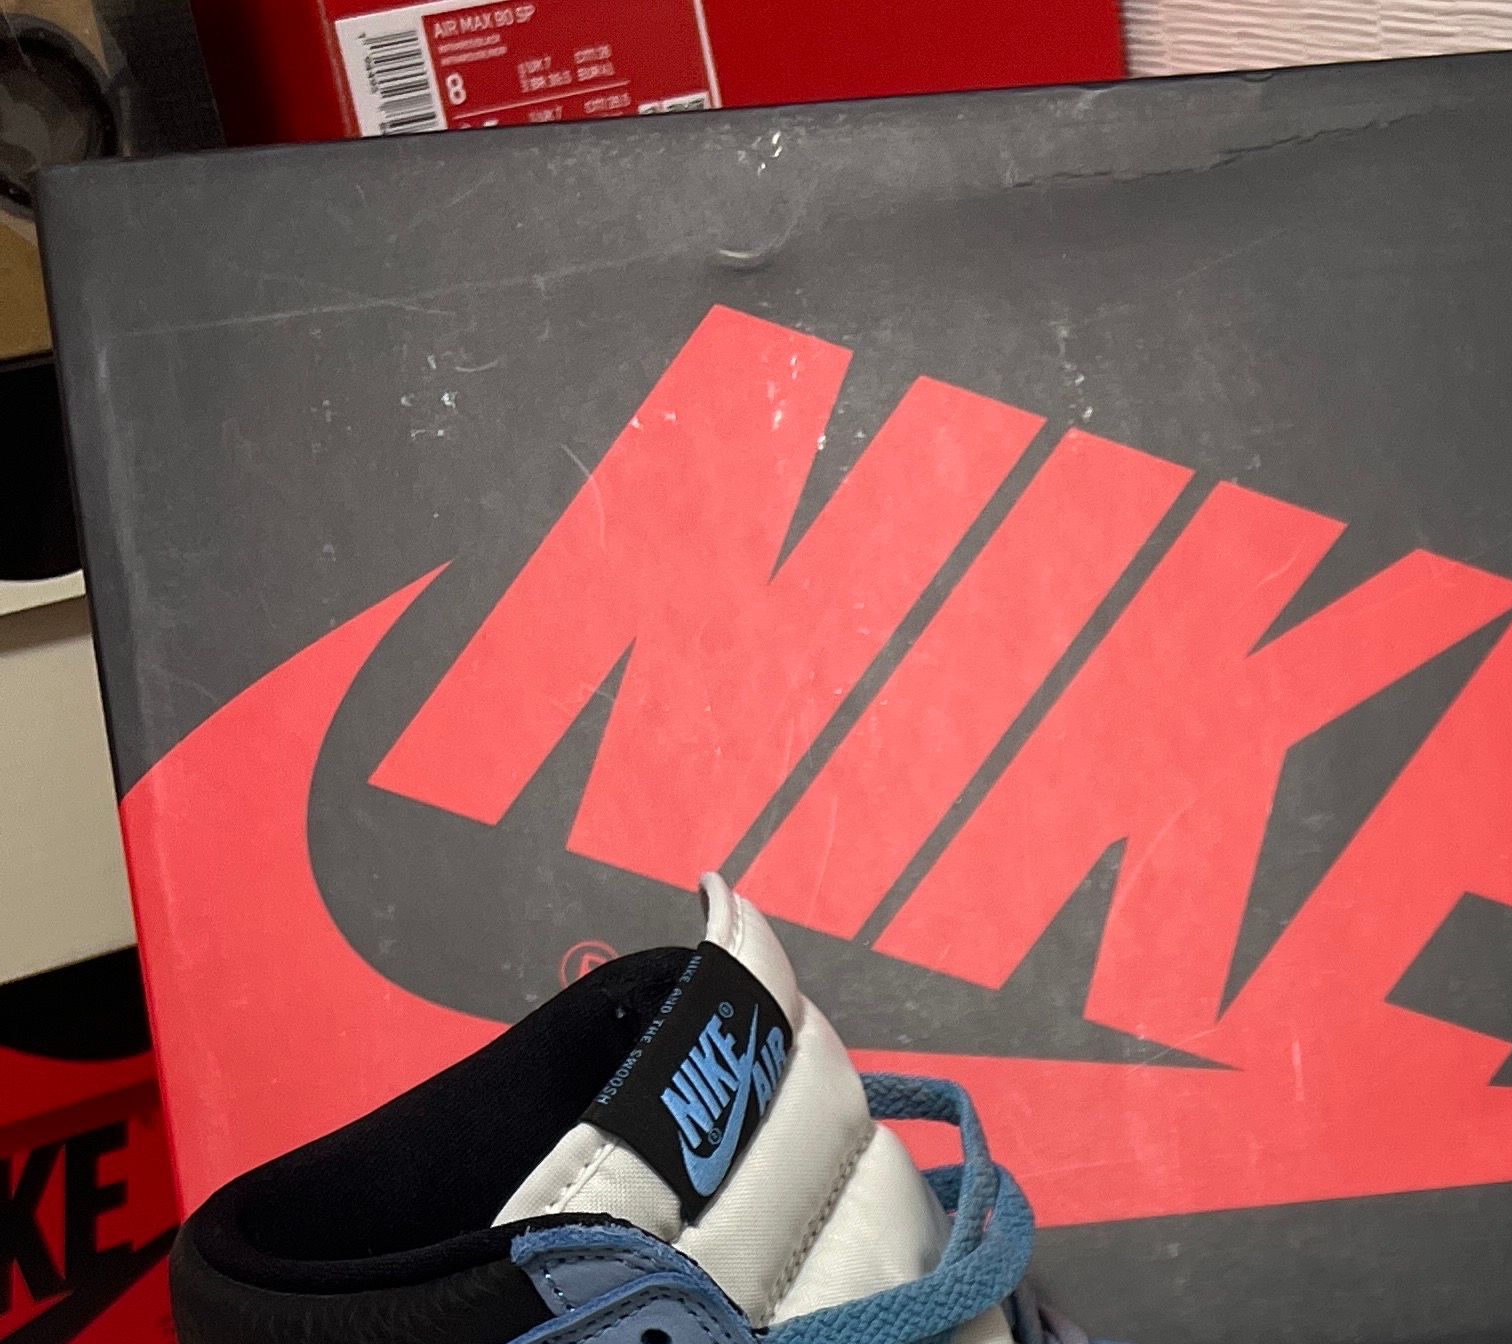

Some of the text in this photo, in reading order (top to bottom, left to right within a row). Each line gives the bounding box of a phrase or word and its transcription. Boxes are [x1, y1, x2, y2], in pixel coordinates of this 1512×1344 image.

[460, 13, 493, 35] MAX
[446, 72, 467, 105] 8
[679, 955, 702, 983] NIKE
[639, 1018, 665, 1044] THE
[596, 1049, 643, 1105] SWOOSH
[660, 1013, 746, 1150] NIKE
[752, 1025, 789, 1117] AIR
